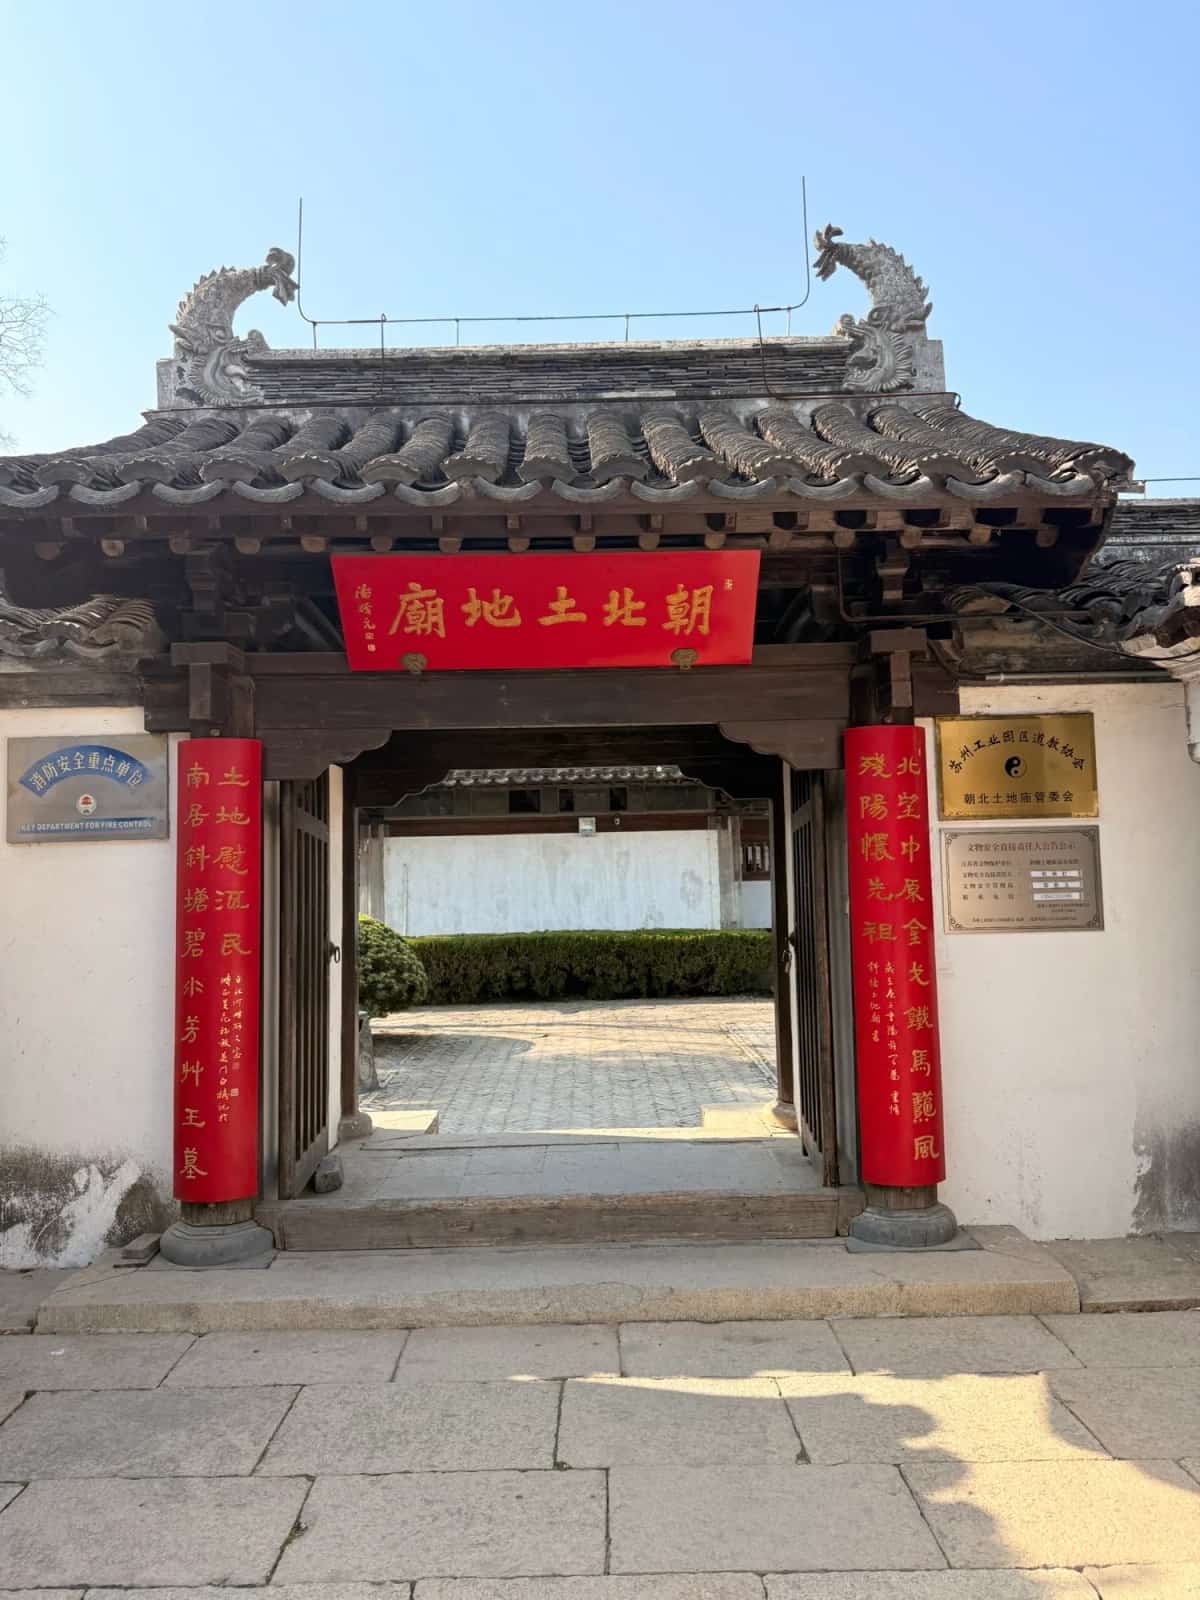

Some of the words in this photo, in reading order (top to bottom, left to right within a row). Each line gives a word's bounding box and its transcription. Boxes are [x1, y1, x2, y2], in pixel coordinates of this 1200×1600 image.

[388, 582, 714, 638] 朝北土地廟
[29, 752, 143, 791] 消防安全重点单位
[964, 791, 1073, 804] 朝北土地庙管委会
